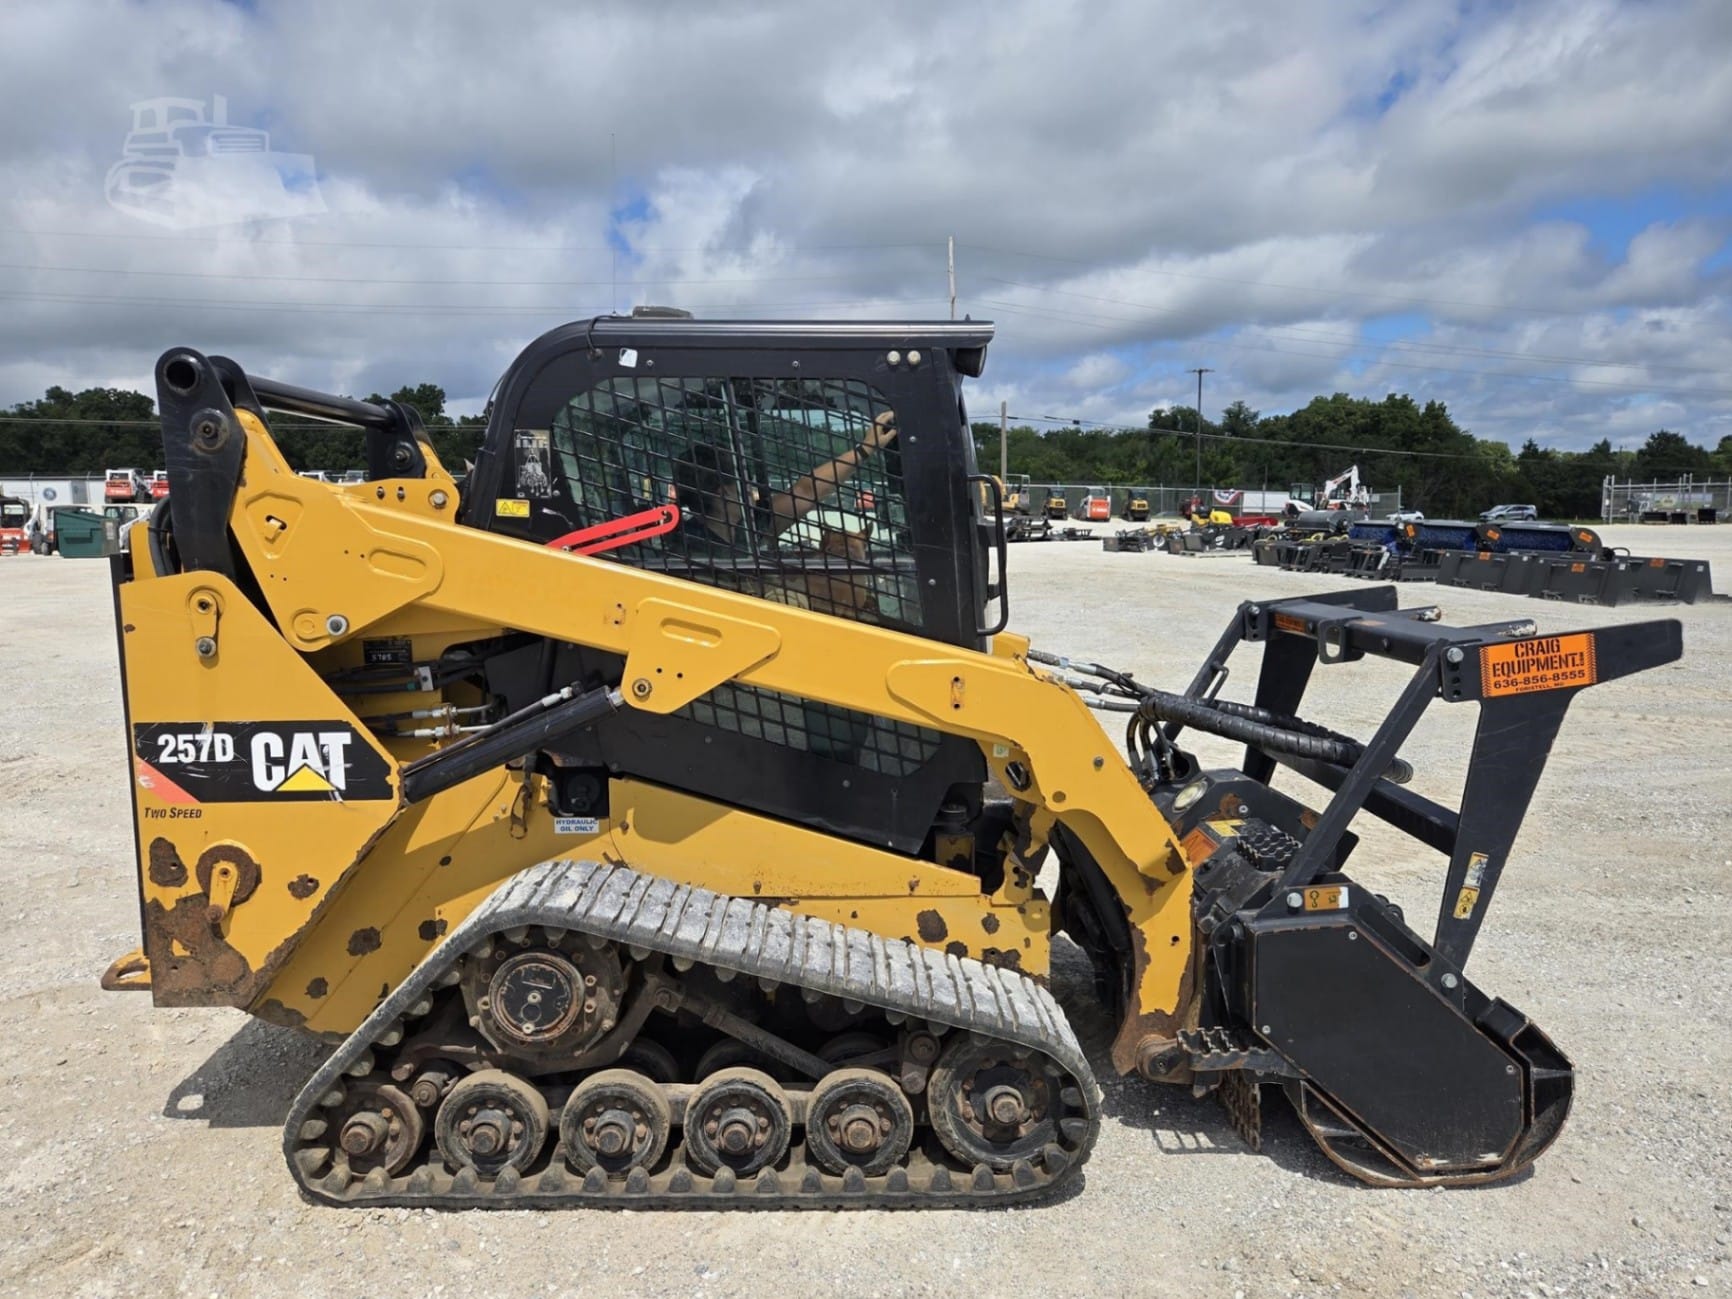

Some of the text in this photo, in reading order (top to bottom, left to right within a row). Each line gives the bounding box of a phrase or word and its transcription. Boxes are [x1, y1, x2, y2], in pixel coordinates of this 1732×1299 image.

[1515, 639, 1560, 658] CRAIG
[1494, 670, 1585, 689] 636-856-8555
[157, 731, 351, 792] 257D CAT
